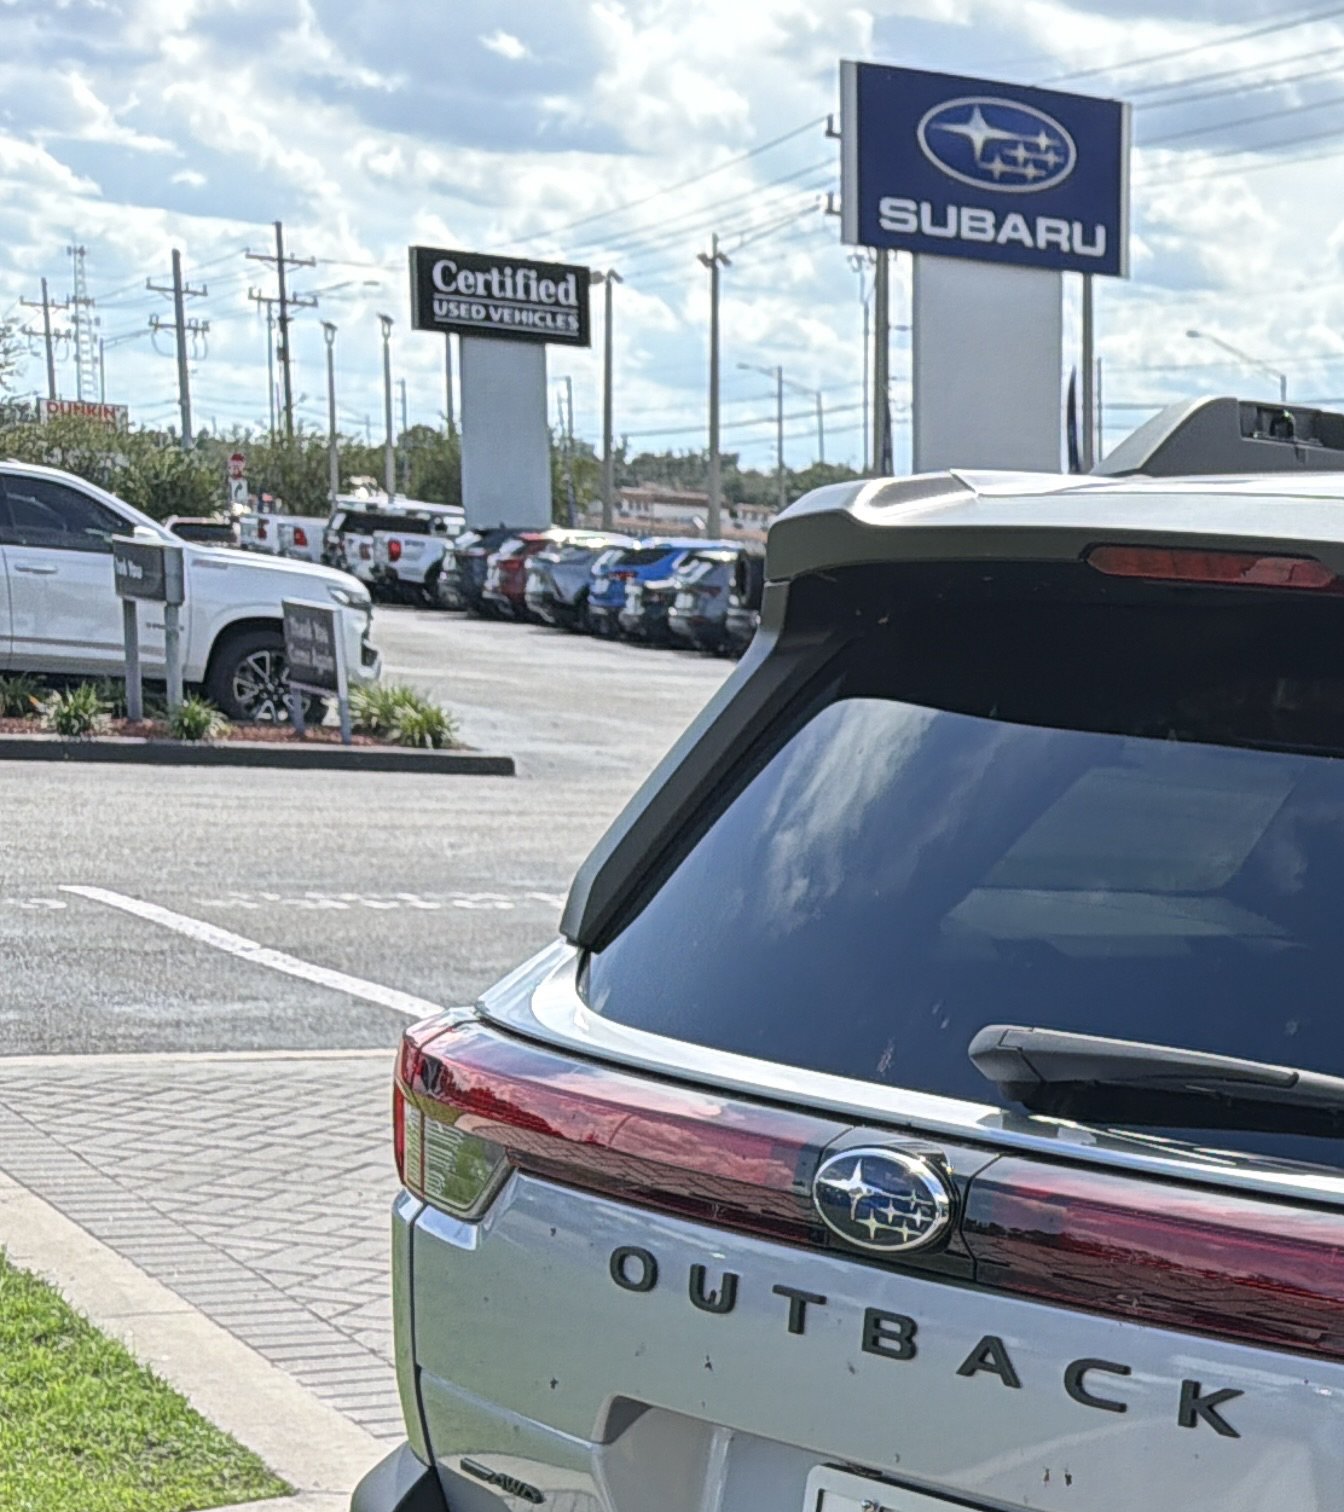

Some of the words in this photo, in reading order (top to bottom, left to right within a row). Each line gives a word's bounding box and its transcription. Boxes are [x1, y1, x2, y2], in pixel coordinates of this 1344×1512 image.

[879, 196, 1106, 257] SUBARU
[432, 259, 579, 307] Certified
[433, 300, 487, 320] USED
[489, 305, 580, 331] VEHICLES
[608, 1244, 1246, 1439] OUTBACK
